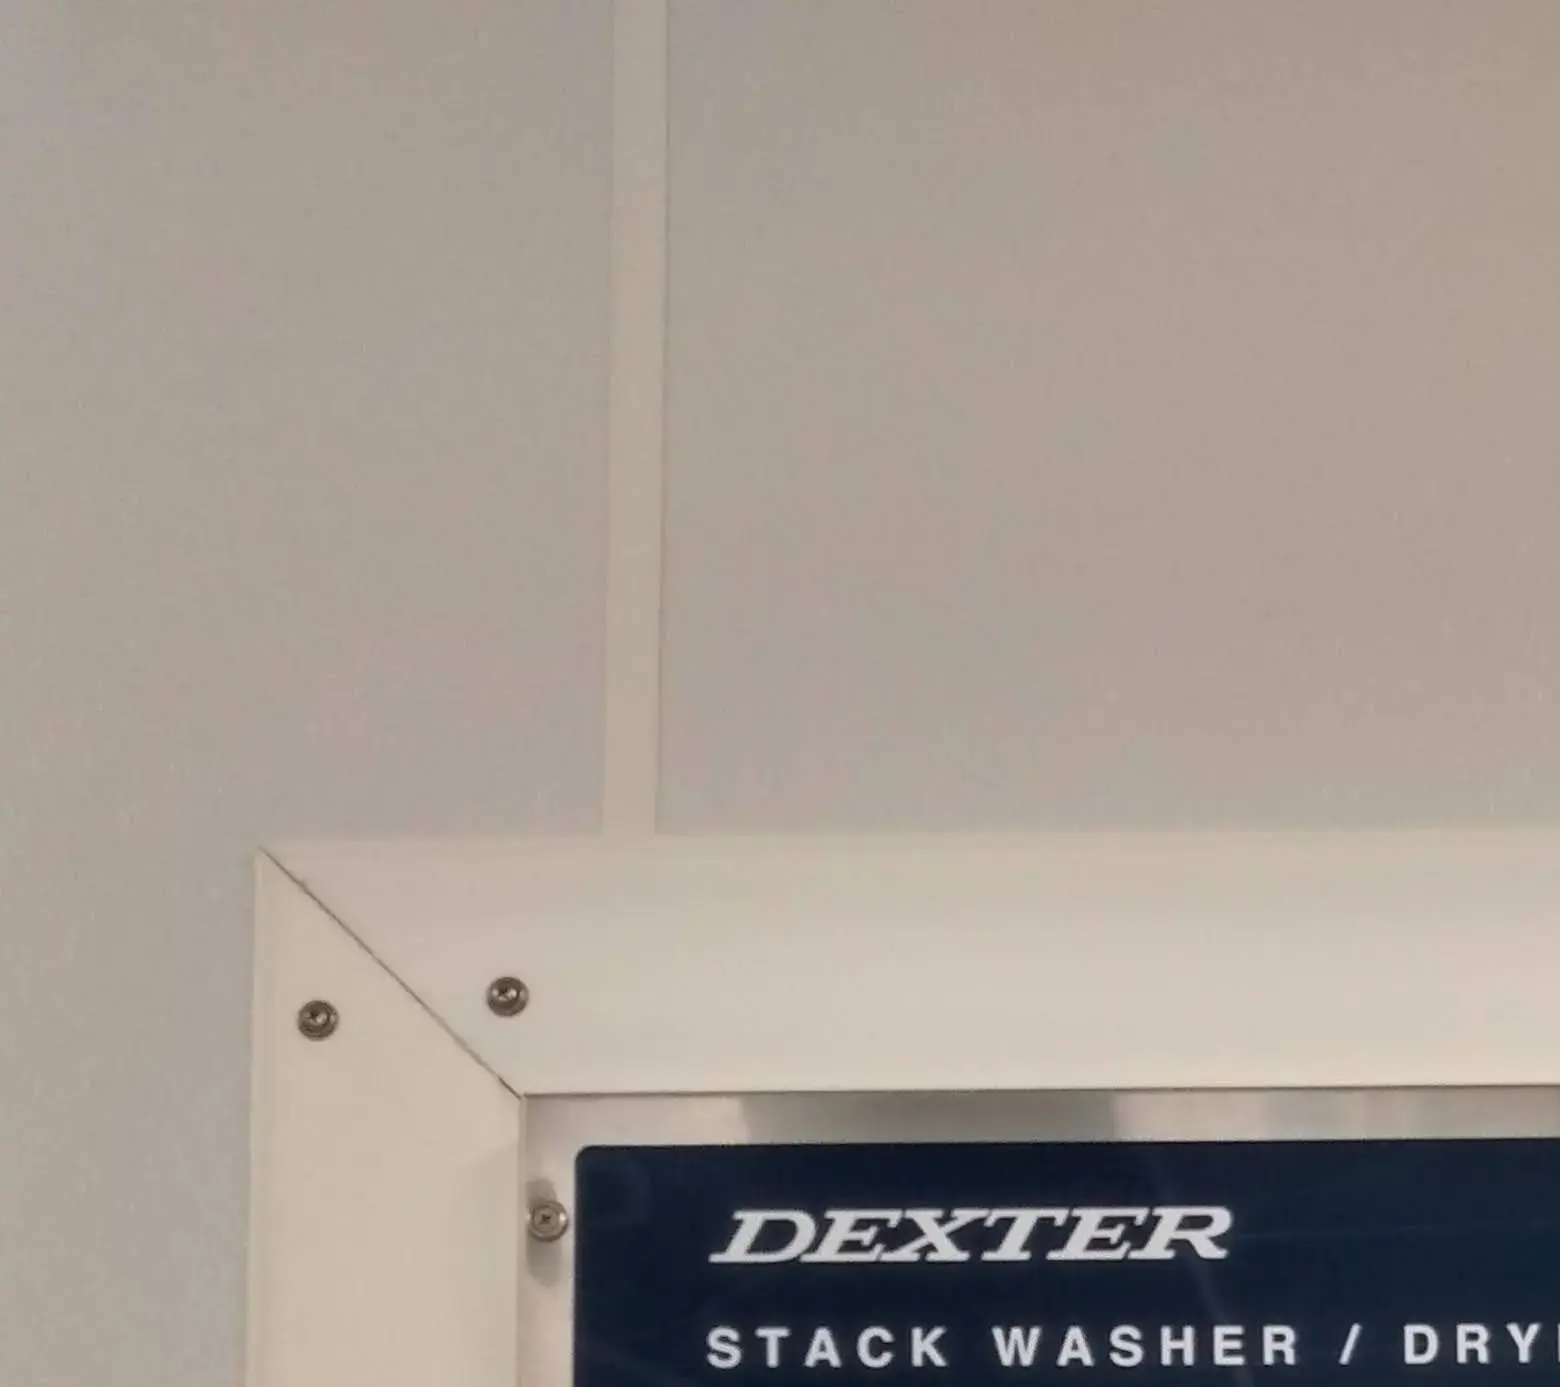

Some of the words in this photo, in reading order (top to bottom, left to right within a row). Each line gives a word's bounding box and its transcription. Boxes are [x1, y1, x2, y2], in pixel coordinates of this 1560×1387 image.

[708, 1206, 1234, 1263] DEXTER
[706, 1326, 948, 1369] STACK
[992, 1324, 1299, 1367] WASHER
[1338, 1324, 1362, 1366] /
